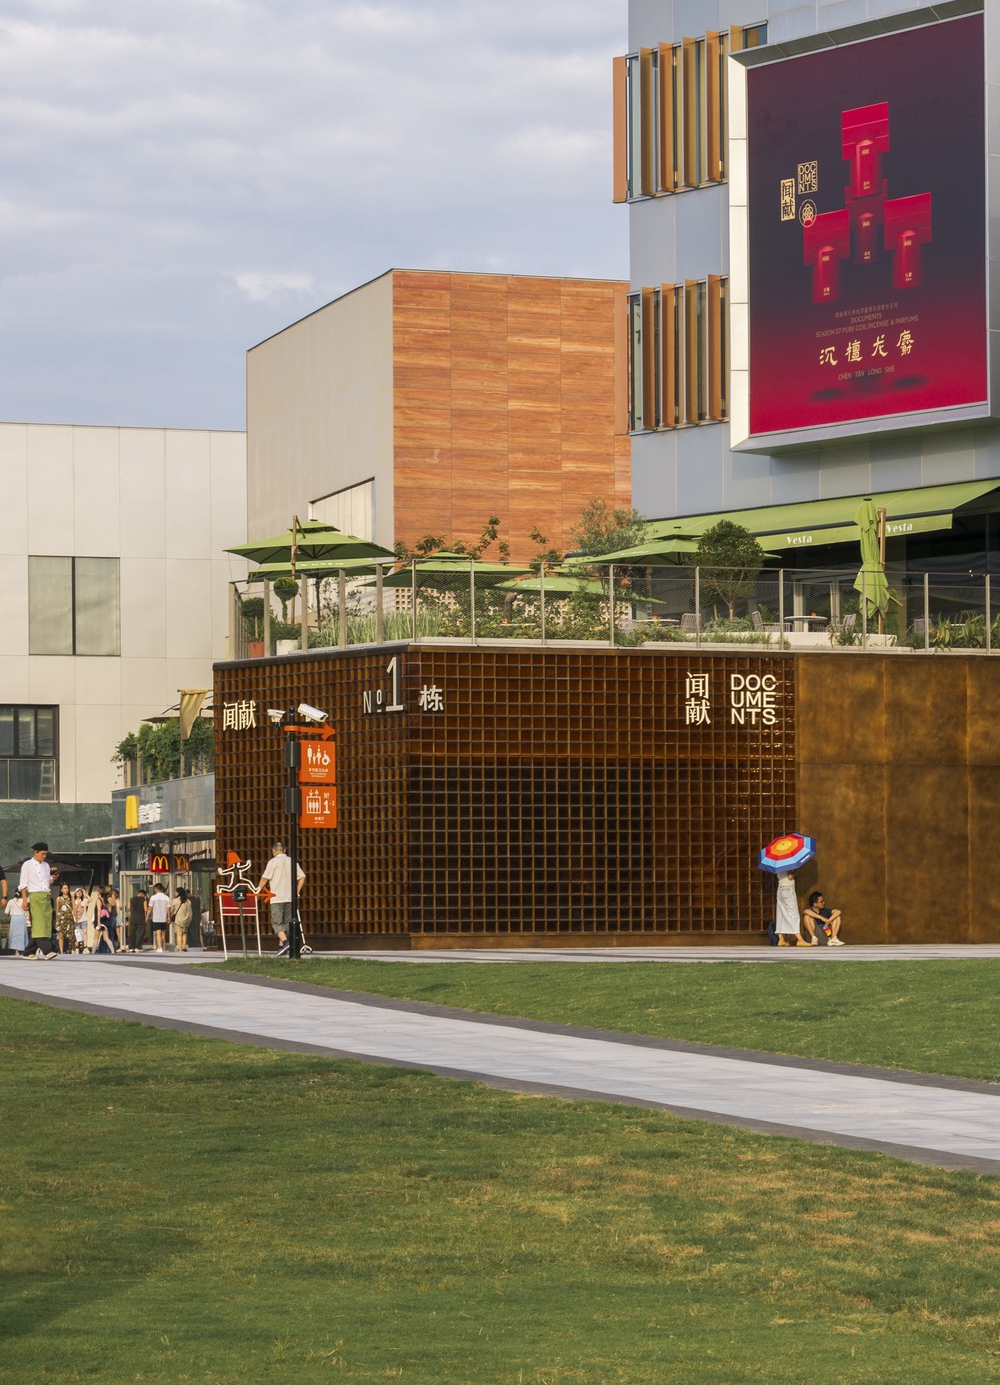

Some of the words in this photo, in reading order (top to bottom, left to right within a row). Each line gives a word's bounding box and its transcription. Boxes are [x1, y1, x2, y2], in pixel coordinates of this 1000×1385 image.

[781, 179, 795, 221] 闻献
[815, 329, 835, 338] SEASON
[842, 325, 855, 334] PURE
[867, 319, 889, 329] INCENSE
[895, 315, 919, 325] PARFUMS
[850, 312, 882, 324] DOCUMENTS
[786, 534, 813, 545] Vesta
[886, 522, 913, 533] Vesta
[419, 684, 444, 712] 栋
[685, 672, 711, 726] 闻献
[223, 699, 257, 731] 闻献
